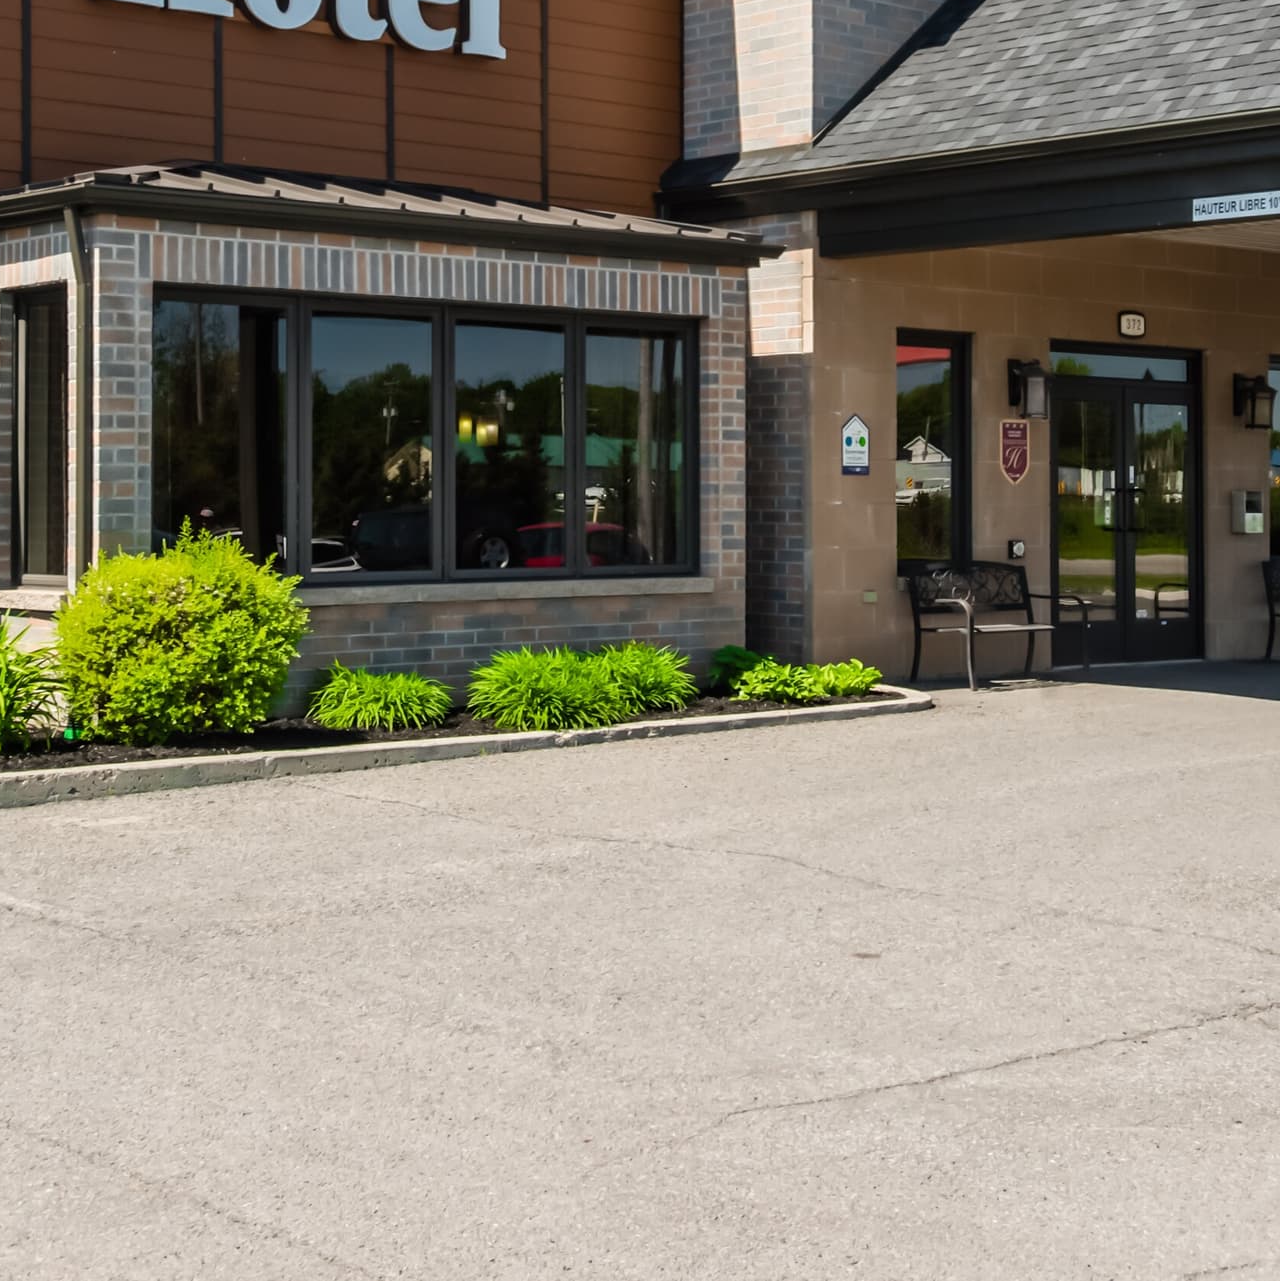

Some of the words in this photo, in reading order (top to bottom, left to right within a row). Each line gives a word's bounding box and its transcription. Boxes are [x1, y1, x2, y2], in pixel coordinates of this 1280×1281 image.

[1194, 200, 1238, 216] HAUTEUR
[1239, 197, 1267, 212] LIBRE
[1125, 318, 1142, 330] 372
